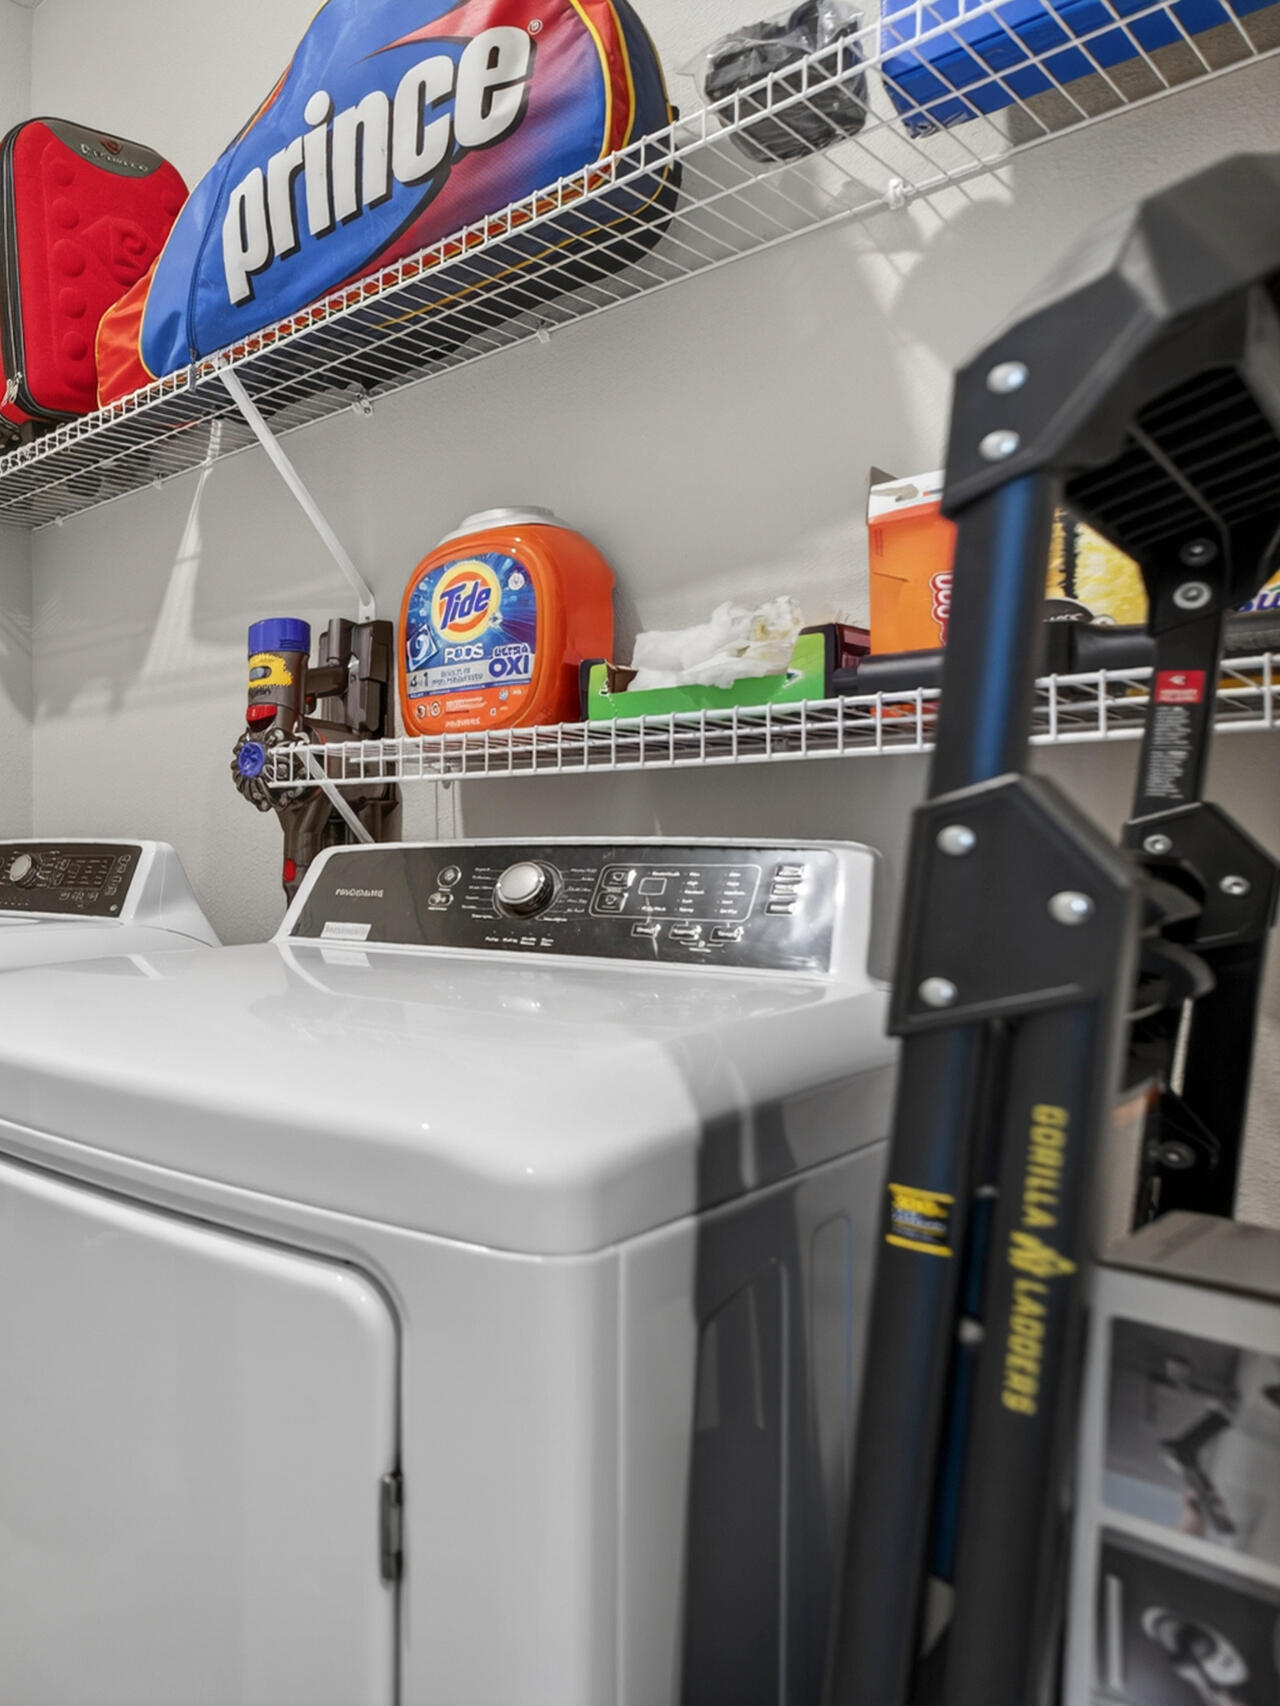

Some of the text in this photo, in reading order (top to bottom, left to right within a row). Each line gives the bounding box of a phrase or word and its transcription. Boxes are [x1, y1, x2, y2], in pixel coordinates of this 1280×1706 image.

[222, 25, 532, 306] prince
[439, 580, 492, 630] Tide
[444, 643, 485, 664] PODS
[488, 654, 530, 679] OXI
[1001, 1103, 1069, 1416] GORILLA LADDERS
